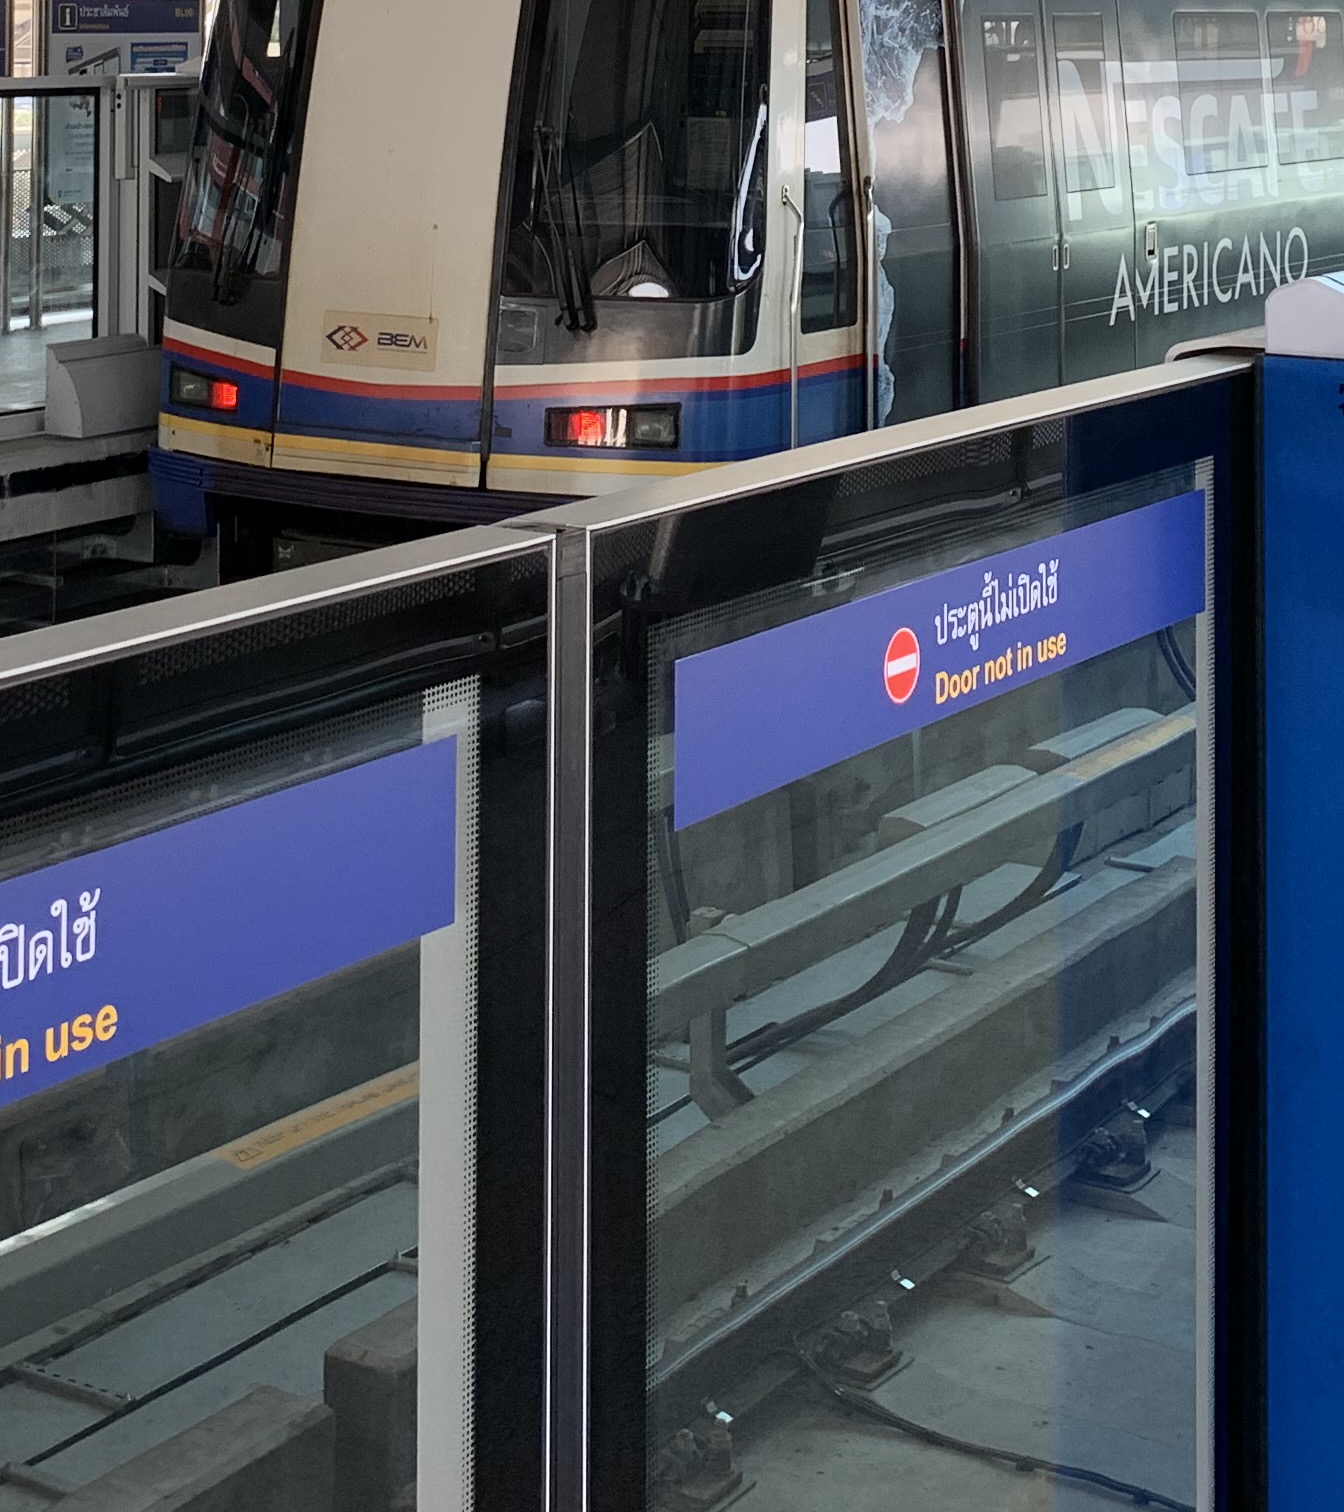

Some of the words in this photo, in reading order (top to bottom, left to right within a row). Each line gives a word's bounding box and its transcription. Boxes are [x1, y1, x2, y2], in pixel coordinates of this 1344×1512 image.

[1108, 226, 1310, 326] AMERICANO
[377, 332, 428, 349] BEM
[935, 559, 1059, 652] ประตูนี้ไม่เปิดใช้
[935, 663, 980, 705] Door
[984, 646, 1014, 685] not
[1016, 641, 1033, 672] in
[1037, 633, 1068, 664] use
[45, 1004, 119, 1062] use
